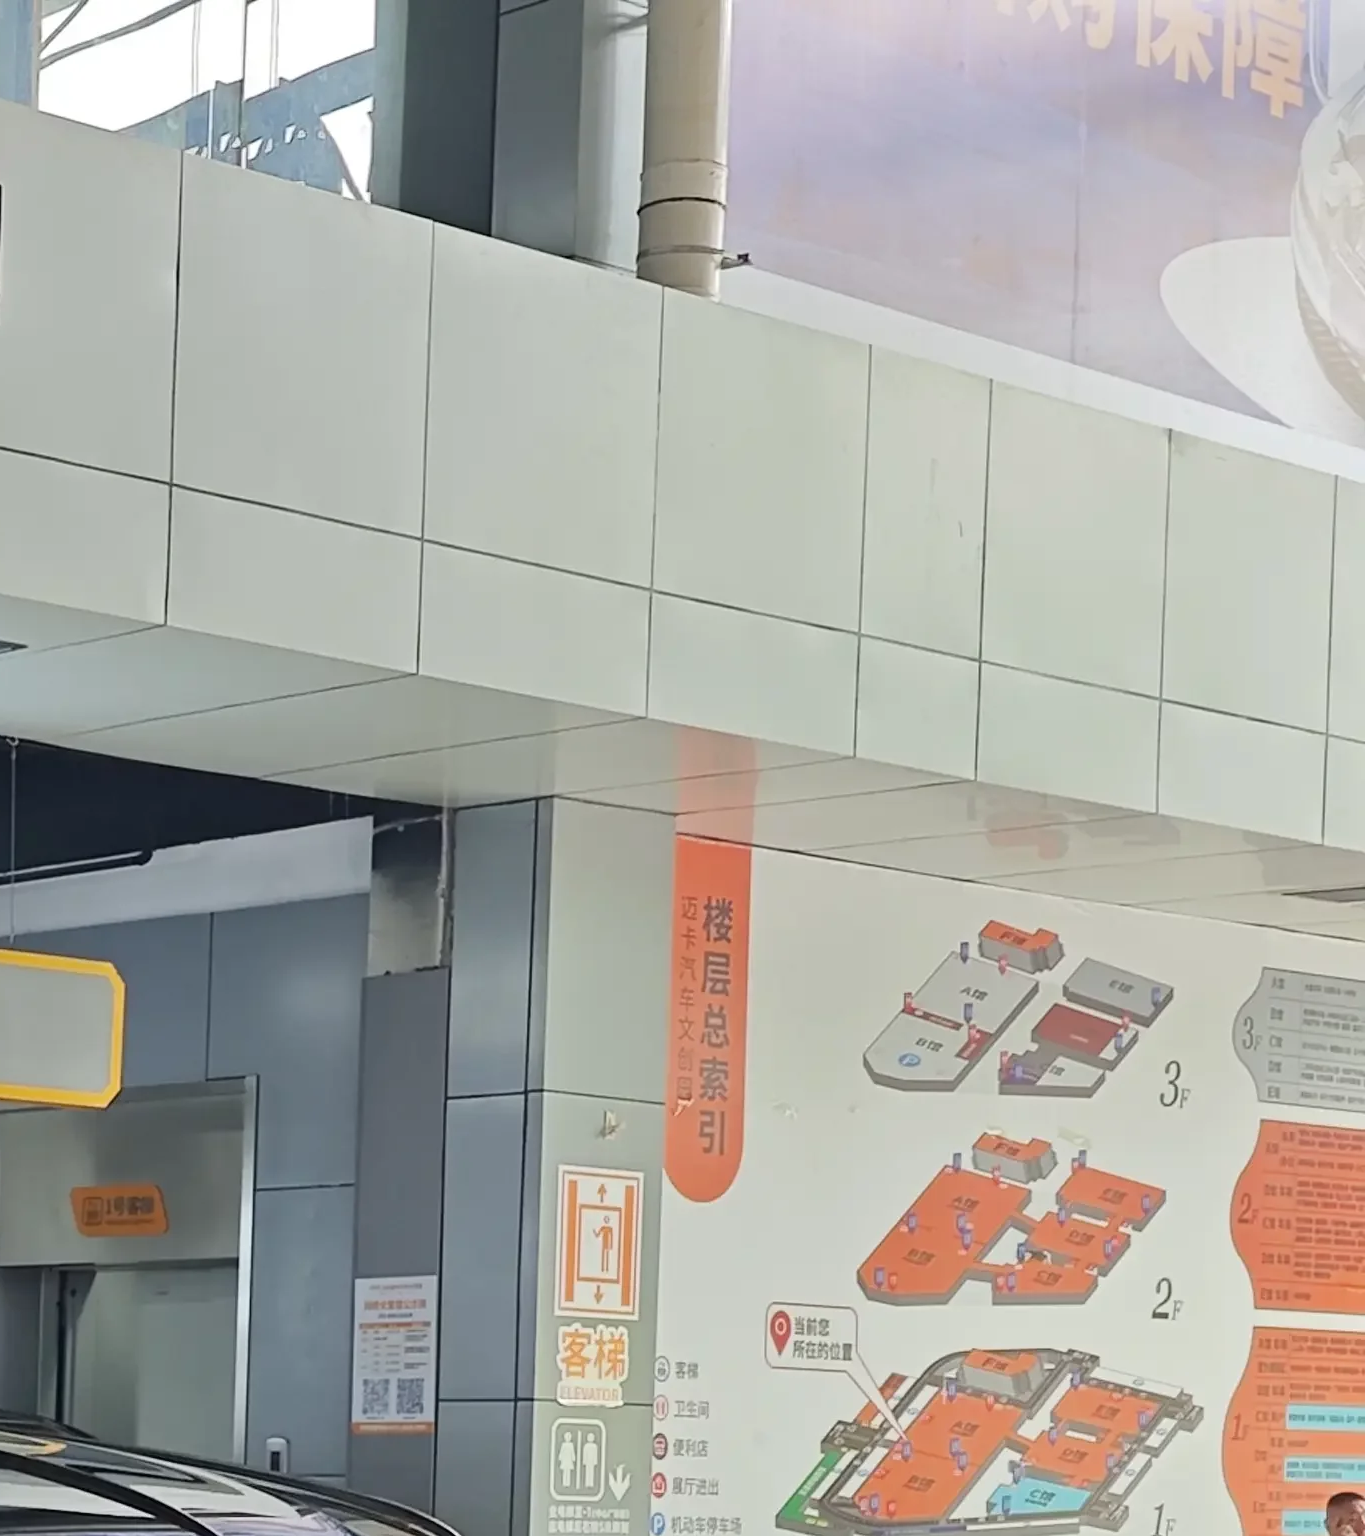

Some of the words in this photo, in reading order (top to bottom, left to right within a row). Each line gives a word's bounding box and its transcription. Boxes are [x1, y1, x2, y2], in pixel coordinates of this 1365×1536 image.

[698, 896, 734, 1156] 楼层总索引
[1160, 1060, 1191, 1109] 3F
[1151, 1277, 1183, 1321] 2F
[794, 1316, 831, 1337] 当前您
[560, 1328, 626, 1380] 客梯
[792, 1341, 854, 1362] 所在的位置
[673, 1400, 710, 1419] 卫生间
[673, 1438, 709, 1457] 便利店
[672, 1476, 719, 1496] 展厅进出
[671, 1516, 742, 1535] 机动车停车场
